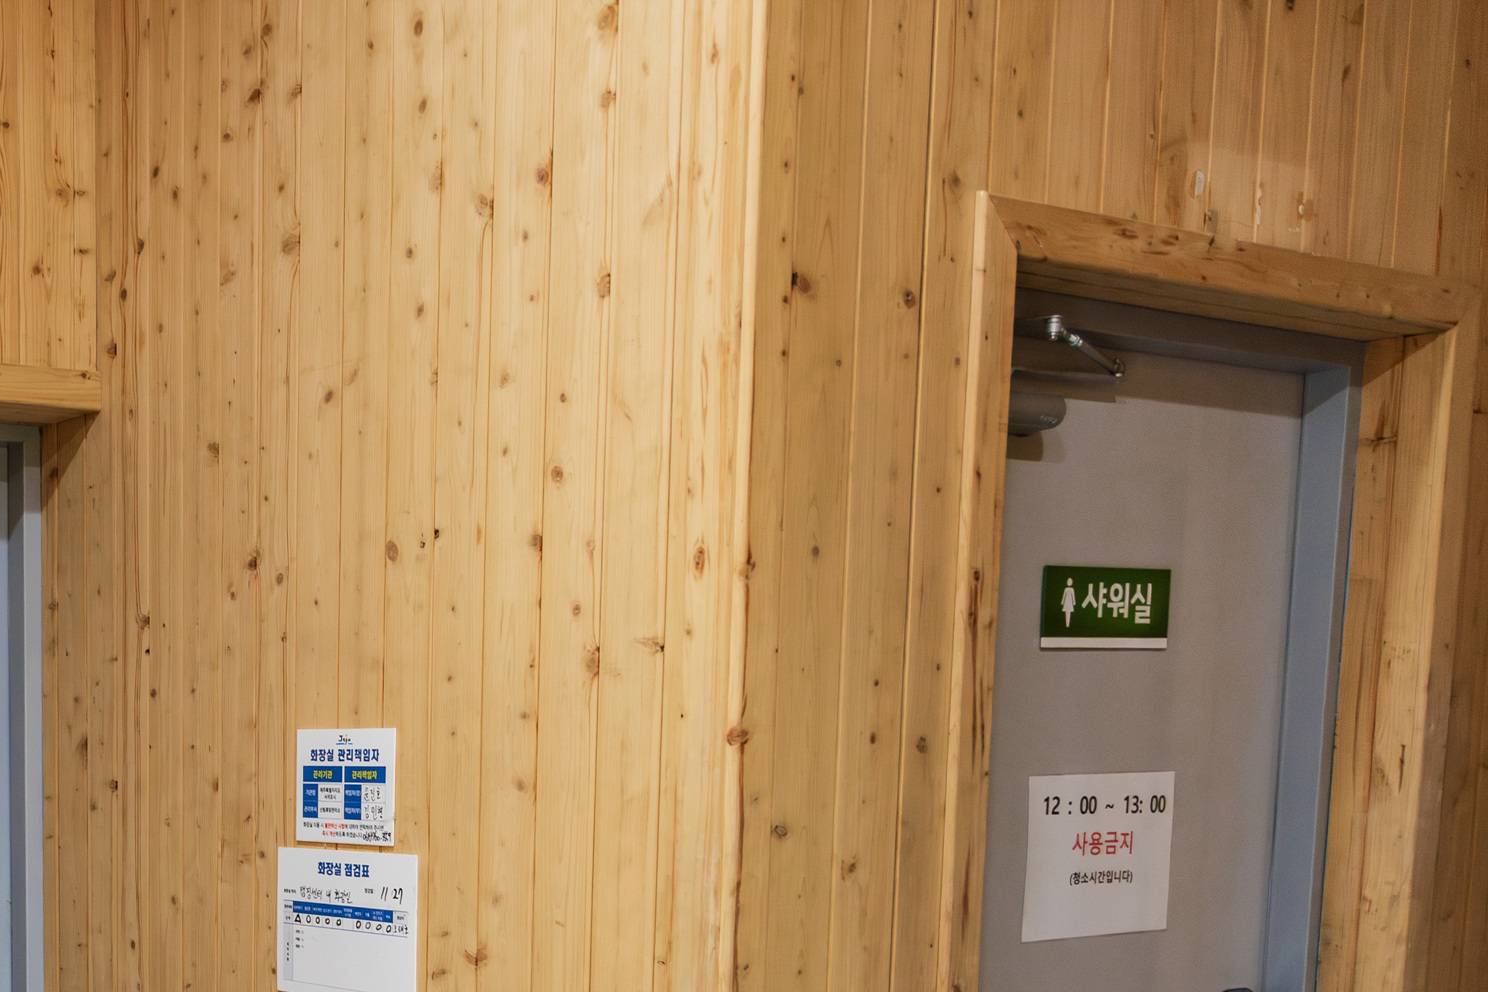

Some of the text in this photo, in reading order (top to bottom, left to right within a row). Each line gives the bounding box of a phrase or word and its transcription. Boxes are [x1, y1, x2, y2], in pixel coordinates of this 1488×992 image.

[1081, 581, 1153, 625] 샤워실
[310, 748, 380, 763] 화장실 관리책임자
[312, 769, 333, 780] 관리기관
[351, 770, 378, 780] 관리책임자
[1043, 795, 1061, 816] 12
[1079, 795, 1098, 815] 00
[1105, 802, 1115, 810] ~
[1150, 794, 1167, 813] 00
[1071, 830, 1134, 857] 사용금지
[317, 861, 370, 878] 화장실 점검표
[1069, 869, 1134, 886] (청소시간입니다)
[392, 887, 404, 905] 27
